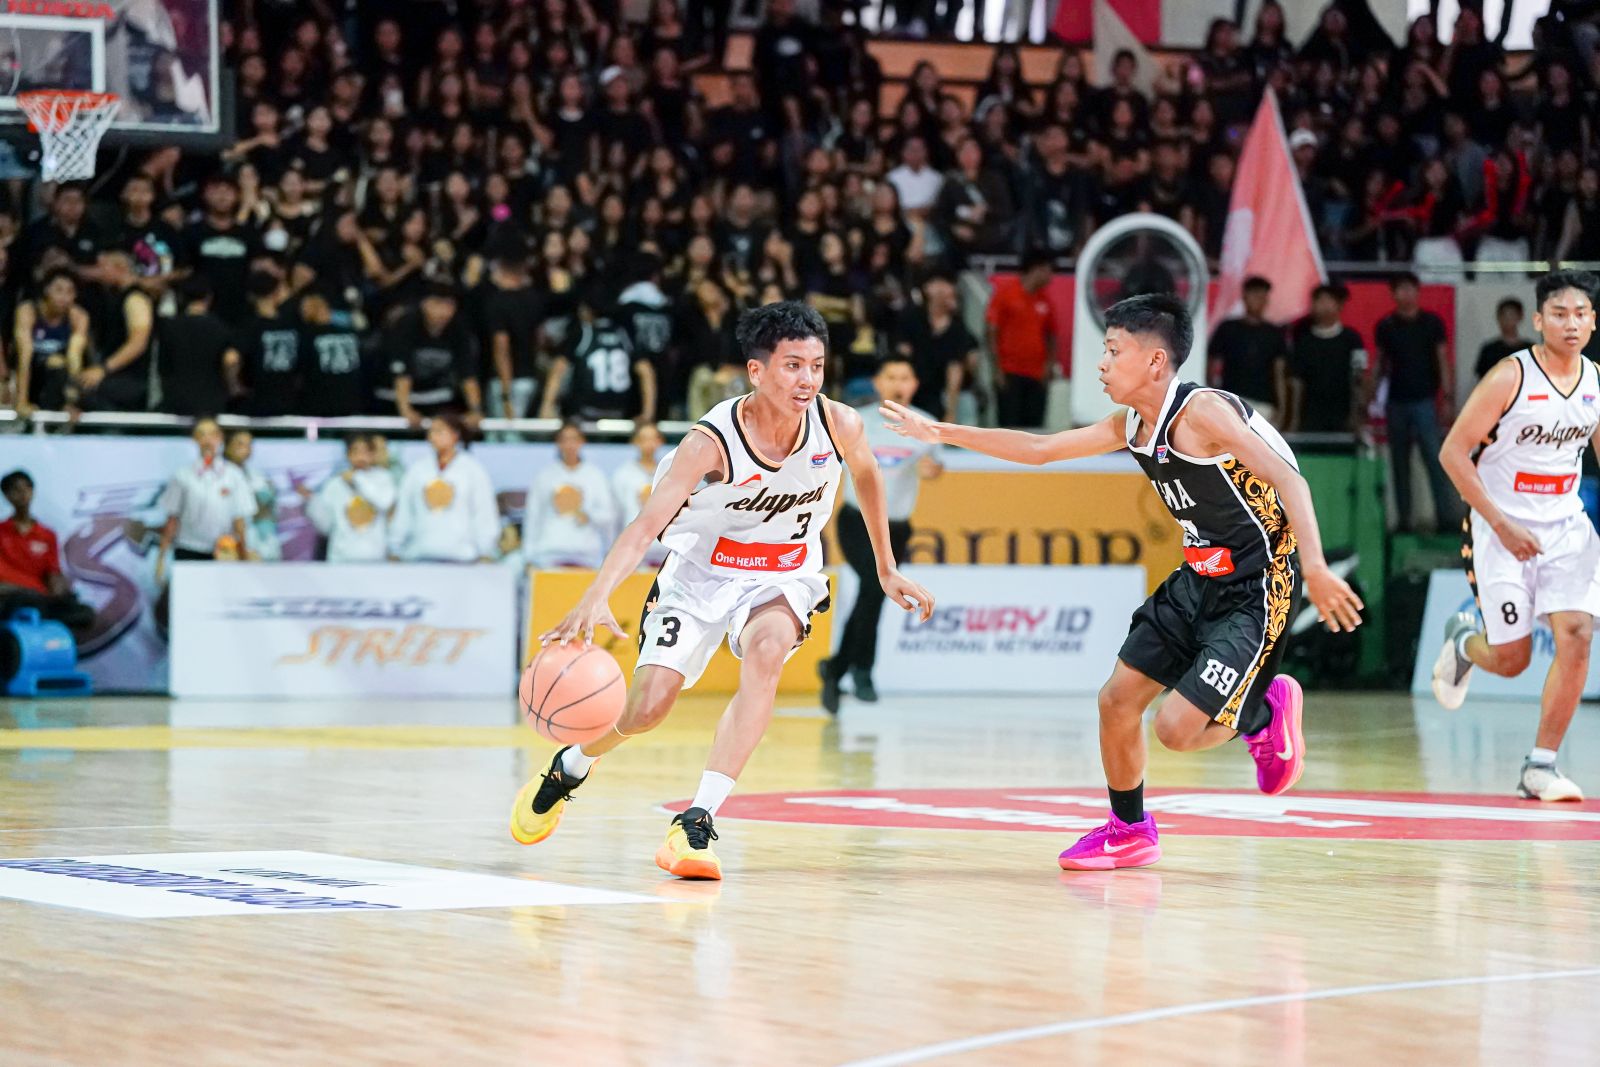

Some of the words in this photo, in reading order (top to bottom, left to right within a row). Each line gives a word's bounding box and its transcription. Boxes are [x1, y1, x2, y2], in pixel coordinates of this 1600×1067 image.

[587, 348, 631, 393] 18
[790, 511, 812, 540] 3
[715, 552, 735, 564] One
[1501, 601, 1518, 625] 8
[656, 616, 682, 648] 3
